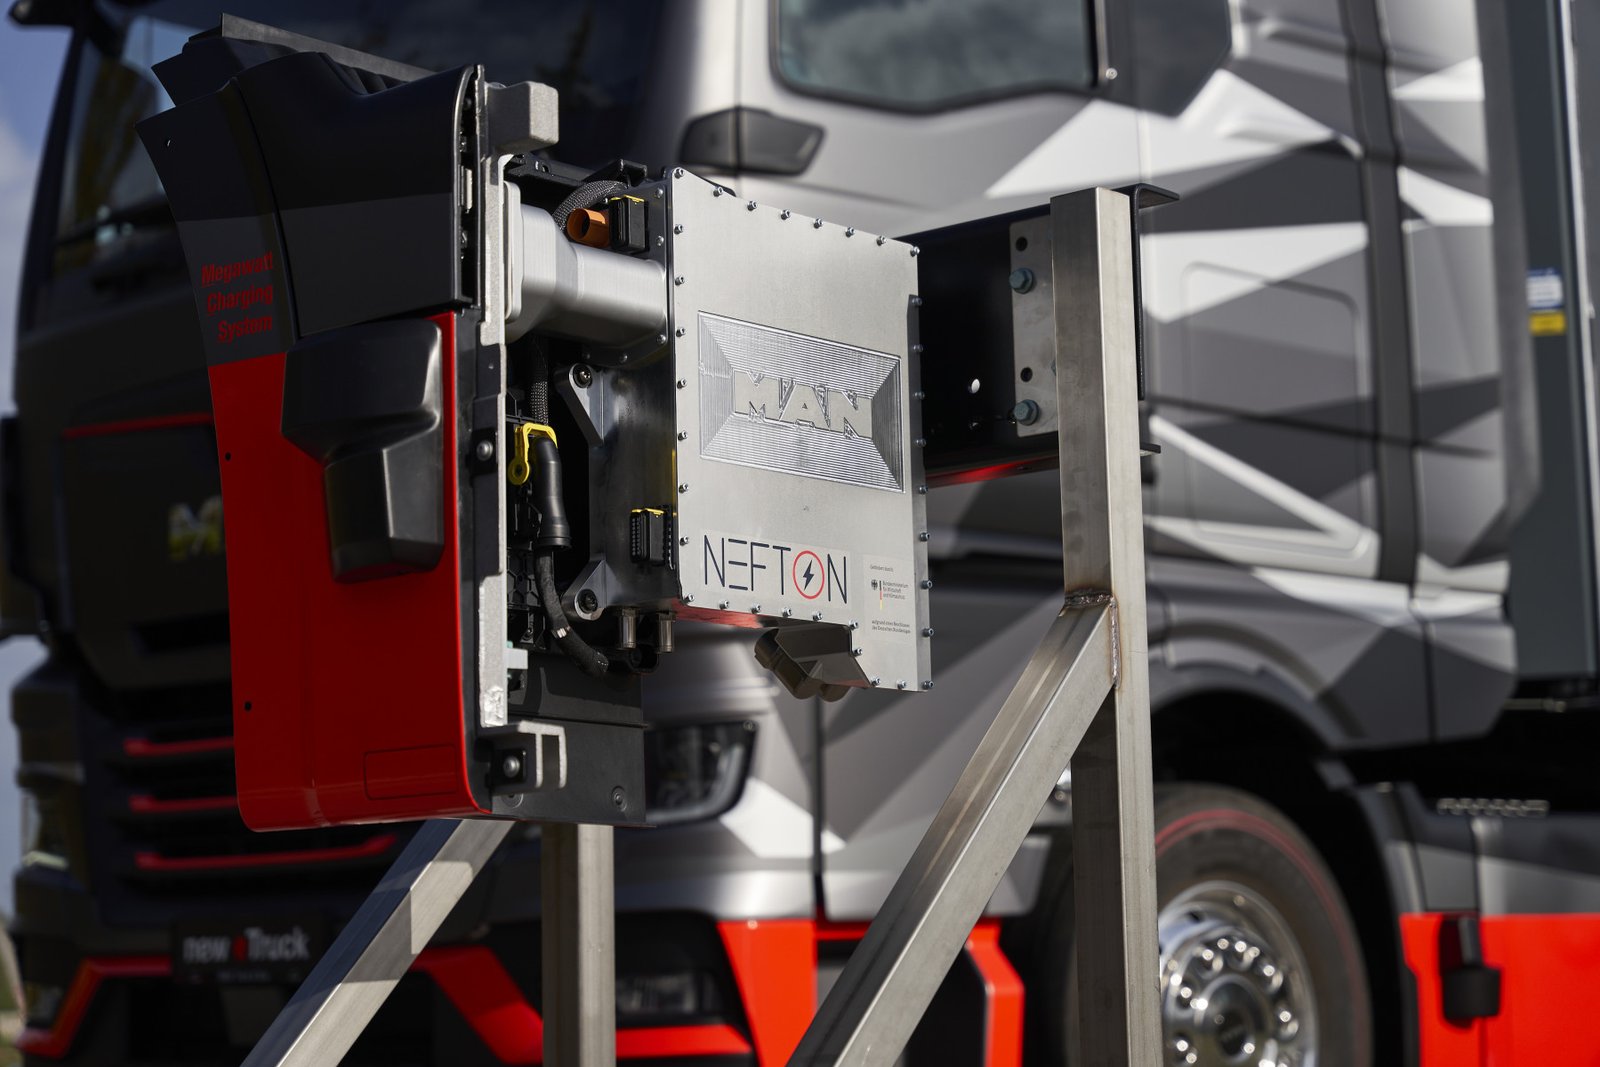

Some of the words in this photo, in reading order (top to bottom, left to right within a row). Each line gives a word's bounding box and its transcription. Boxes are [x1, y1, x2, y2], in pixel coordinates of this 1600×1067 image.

[201, 251, 273, 288] Megawatt
[207, 284, 273, 316] Charging
[217, 316, 273, 343] System
[732, 367, 873, 440] MAN
[704, 534, 847, 604] NEFTON
